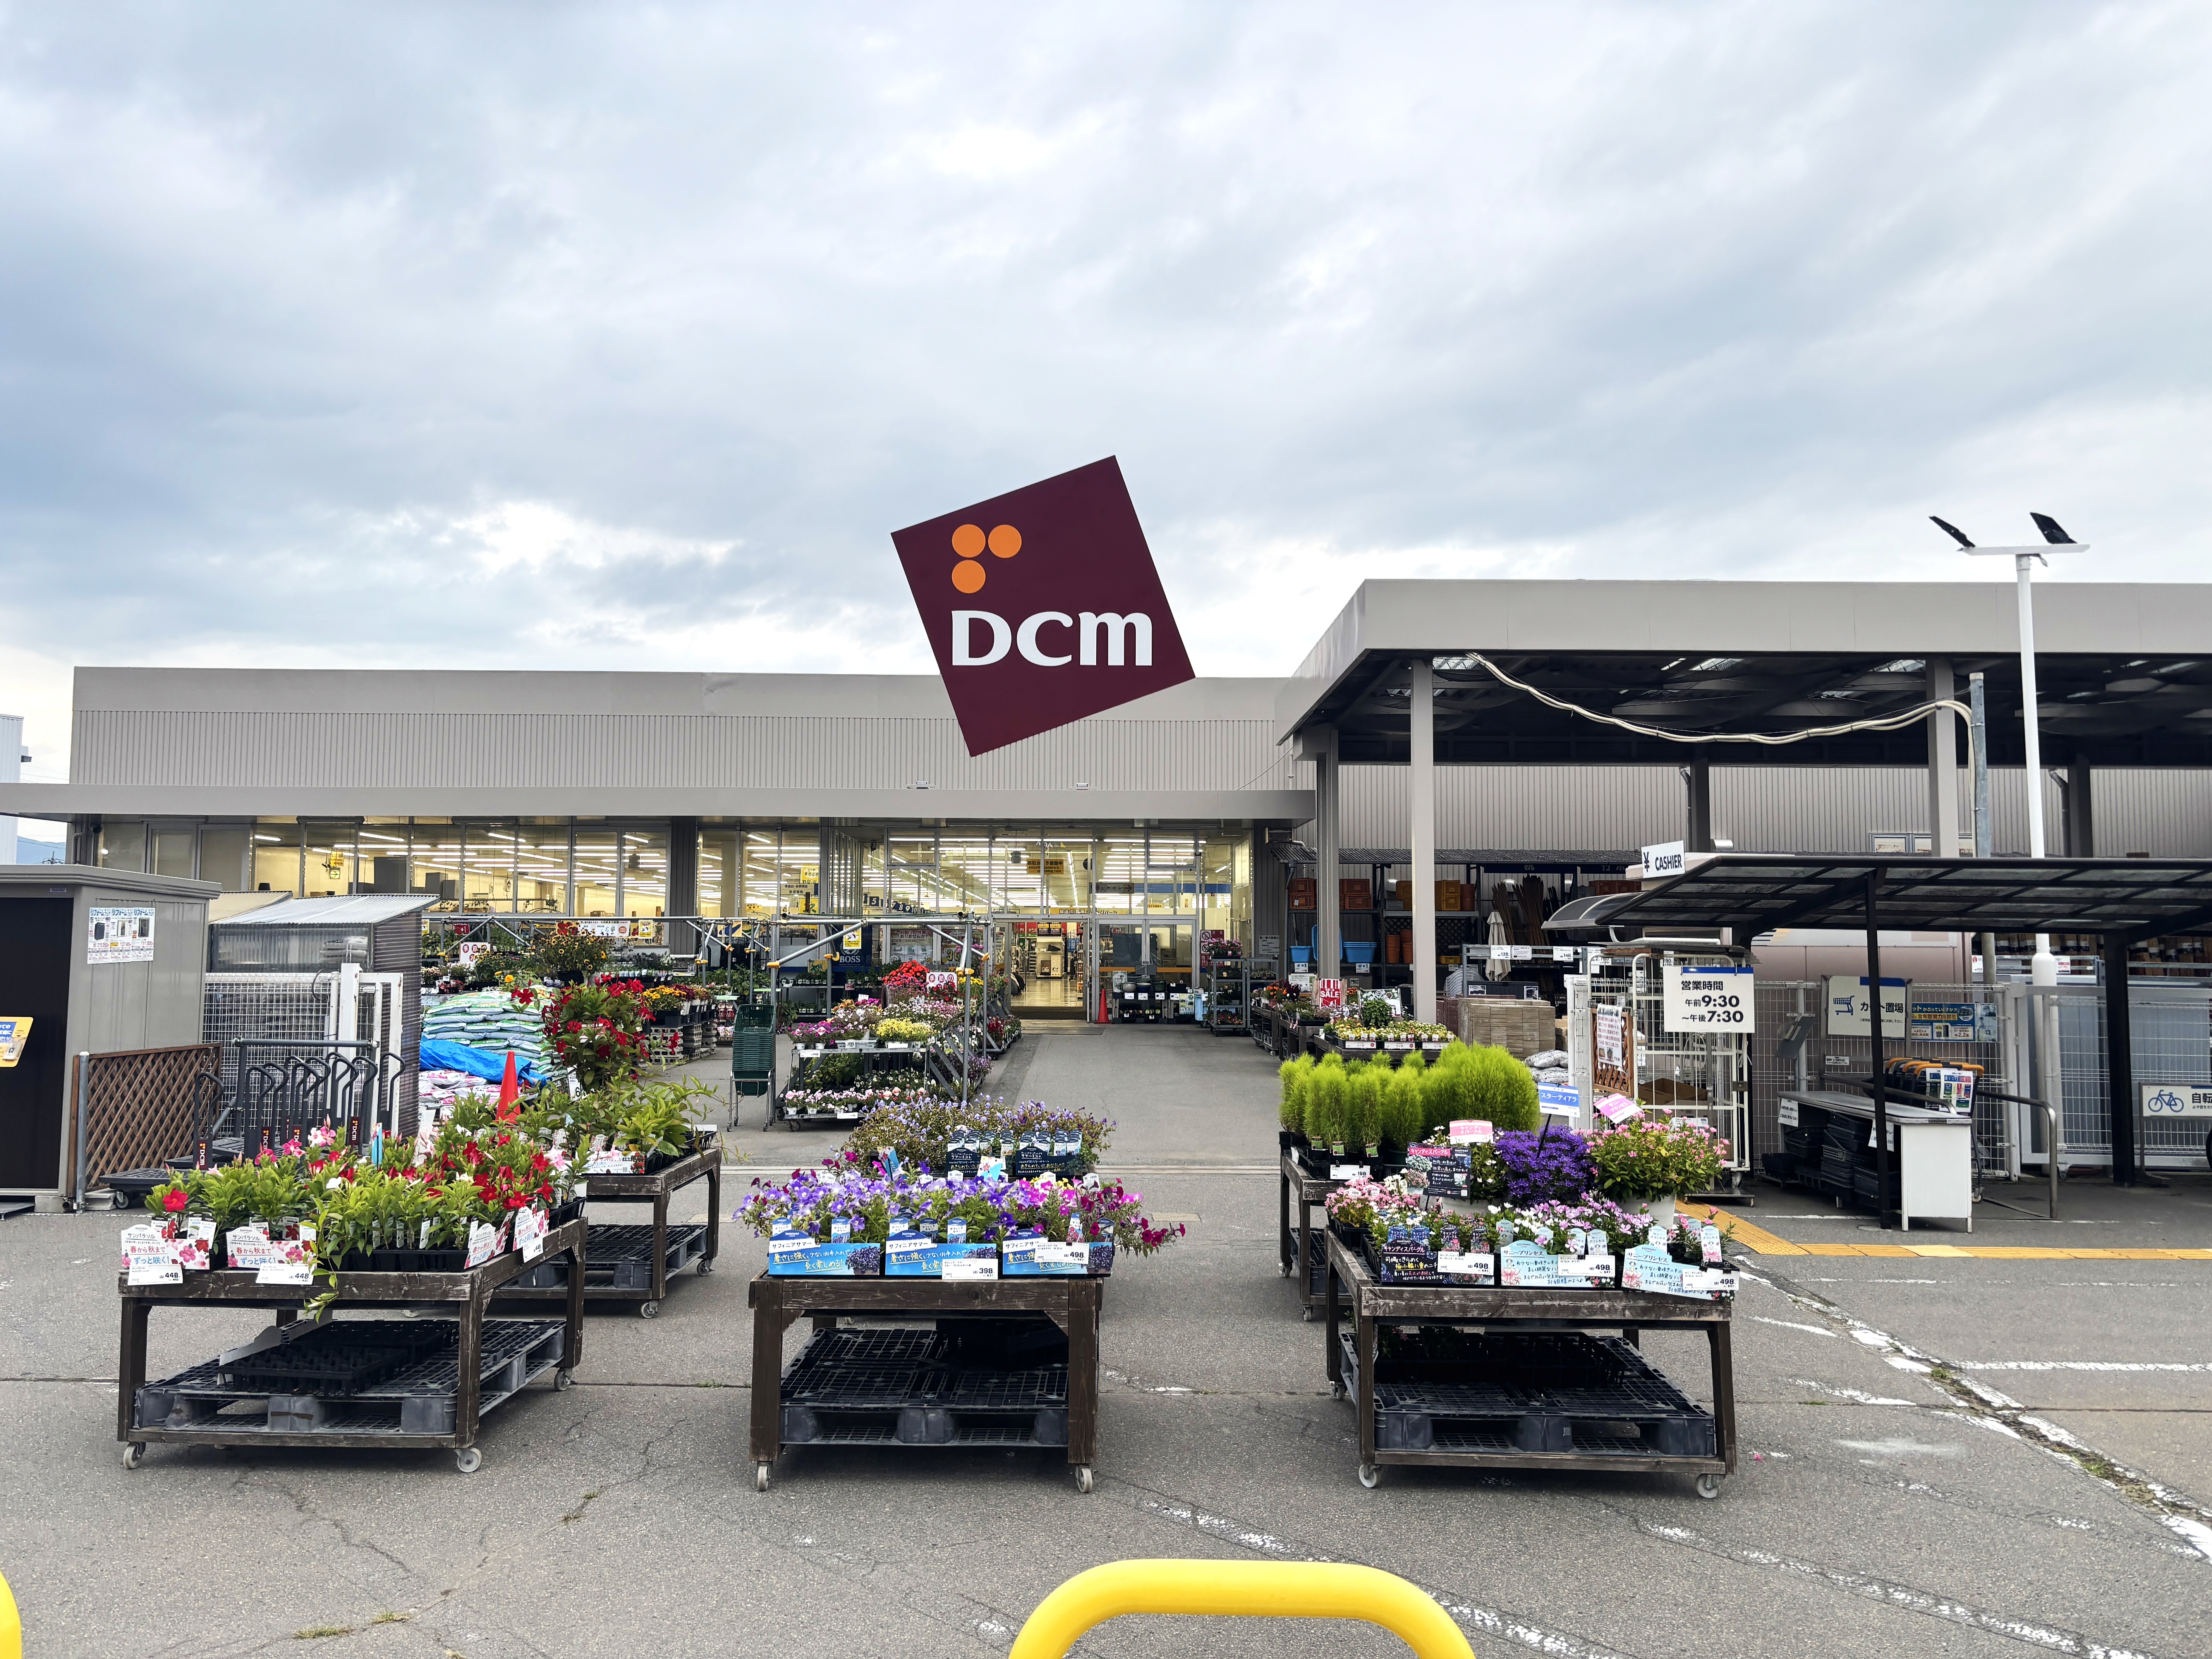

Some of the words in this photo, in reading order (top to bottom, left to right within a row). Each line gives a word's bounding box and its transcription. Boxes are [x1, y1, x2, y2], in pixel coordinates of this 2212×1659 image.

[1655, 854, 1682, 871] CASHIER
[1681, 981, 1723, 991] 営業時間
[1685, 995, 1740, 1007] 午前9:30
[1860, 1002, 1904, 1013] カ置場
[1541, 1092, 1577, 1103] スターティアラ
[134, 1256, 169, 1264] ずっと咲く!
[1628, 1252, 1668, 1263] サニープリンセス
